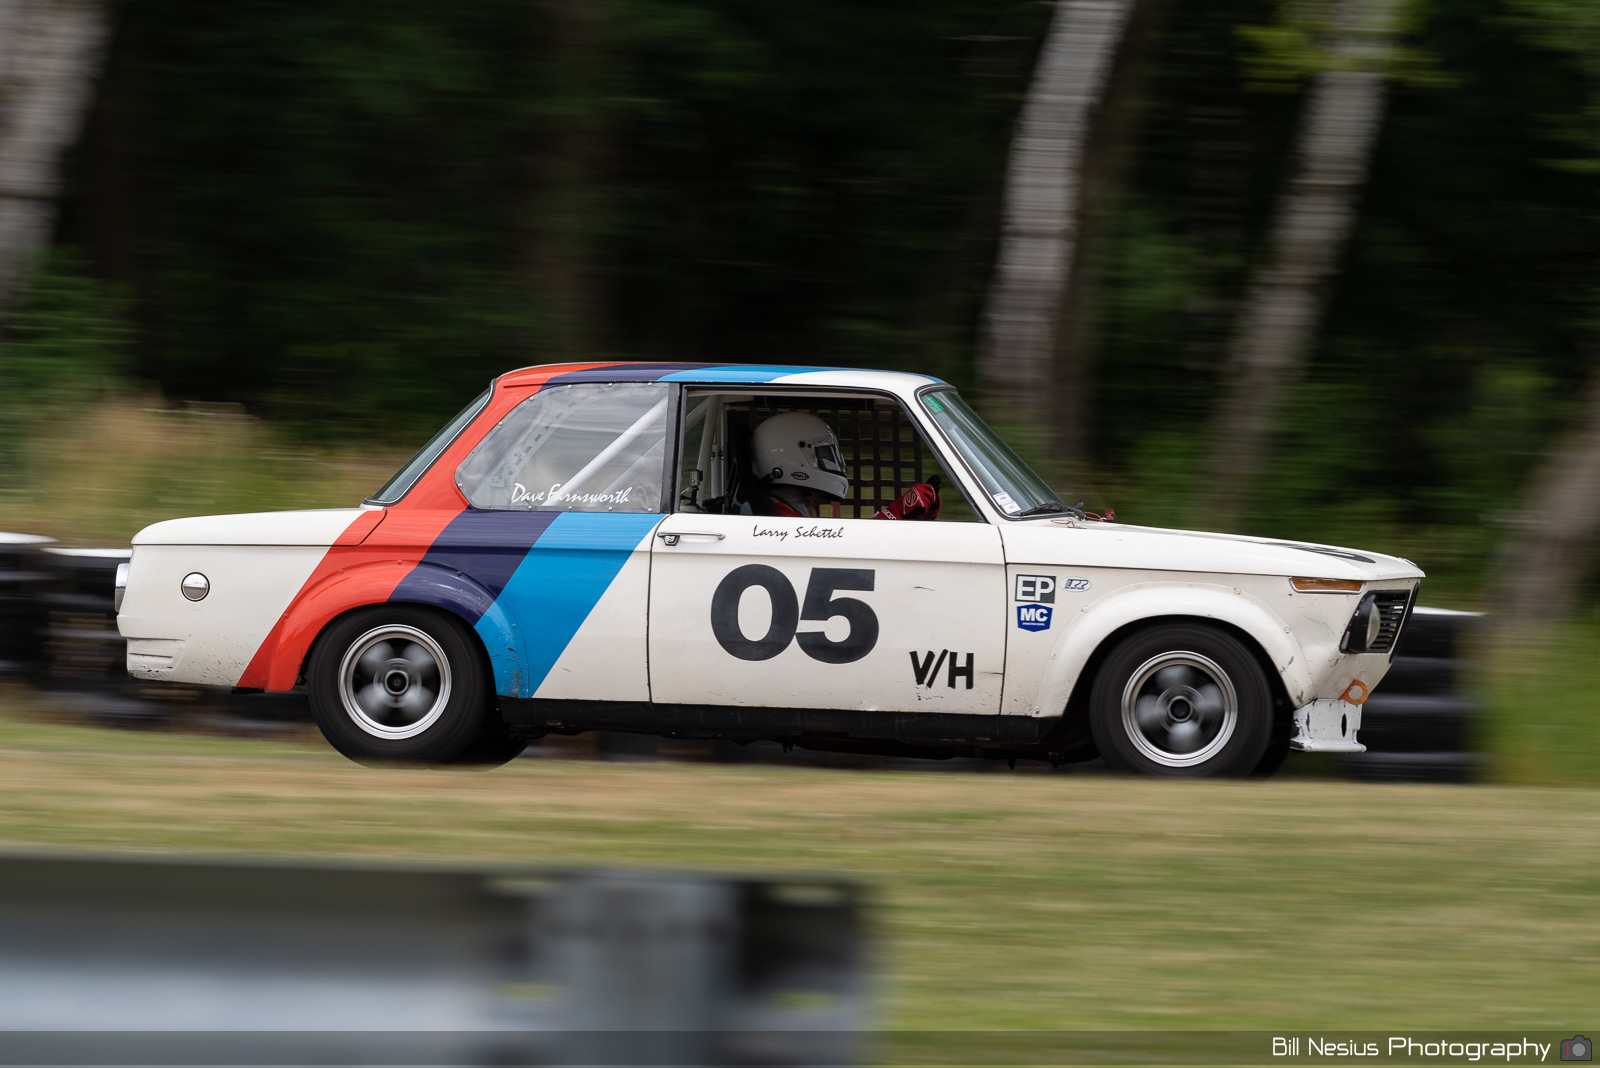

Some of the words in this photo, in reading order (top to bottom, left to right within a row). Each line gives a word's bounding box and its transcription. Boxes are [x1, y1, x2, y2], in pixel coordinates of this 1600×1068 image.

[511, 482, 544, 503] Dave
[753, 525, 788, 541] Larry
[795, 526, 844, 538] Schettel
[1016, 575, 1055, 602] EP
[710, 563, 879, 664] 05
[1020, 608, 1048, 622] MC
[909, 649, 974, 690] V/H
